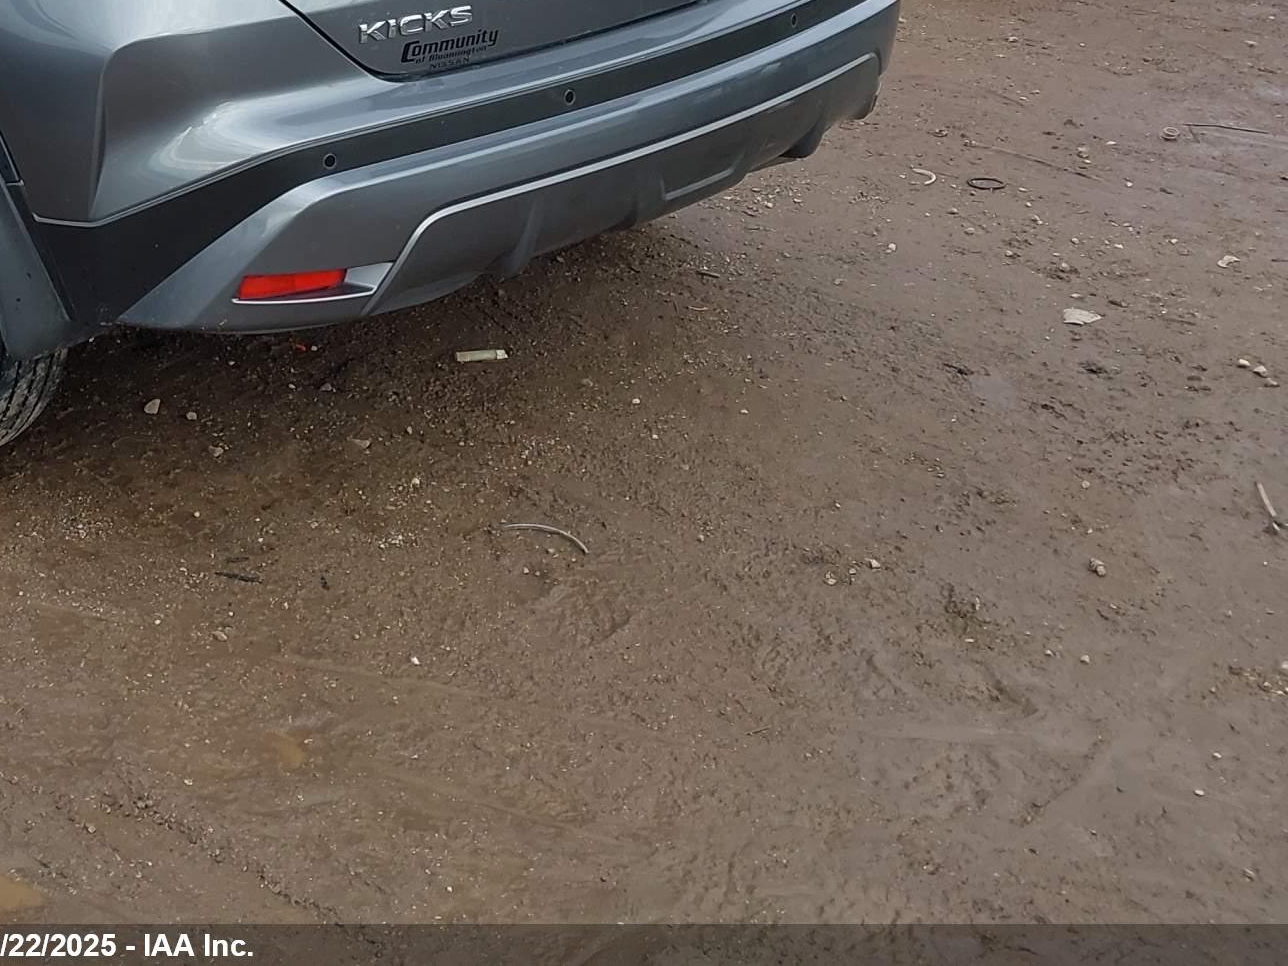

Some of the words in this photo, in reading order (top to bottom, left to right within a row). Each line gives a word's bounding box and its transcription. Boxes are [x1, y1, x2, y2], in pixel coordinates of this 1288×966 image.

[358, 5, 472, 44] KICKS
[401, 28, 499, 63] Community
[431, 57, 471, 69] NISSAN
